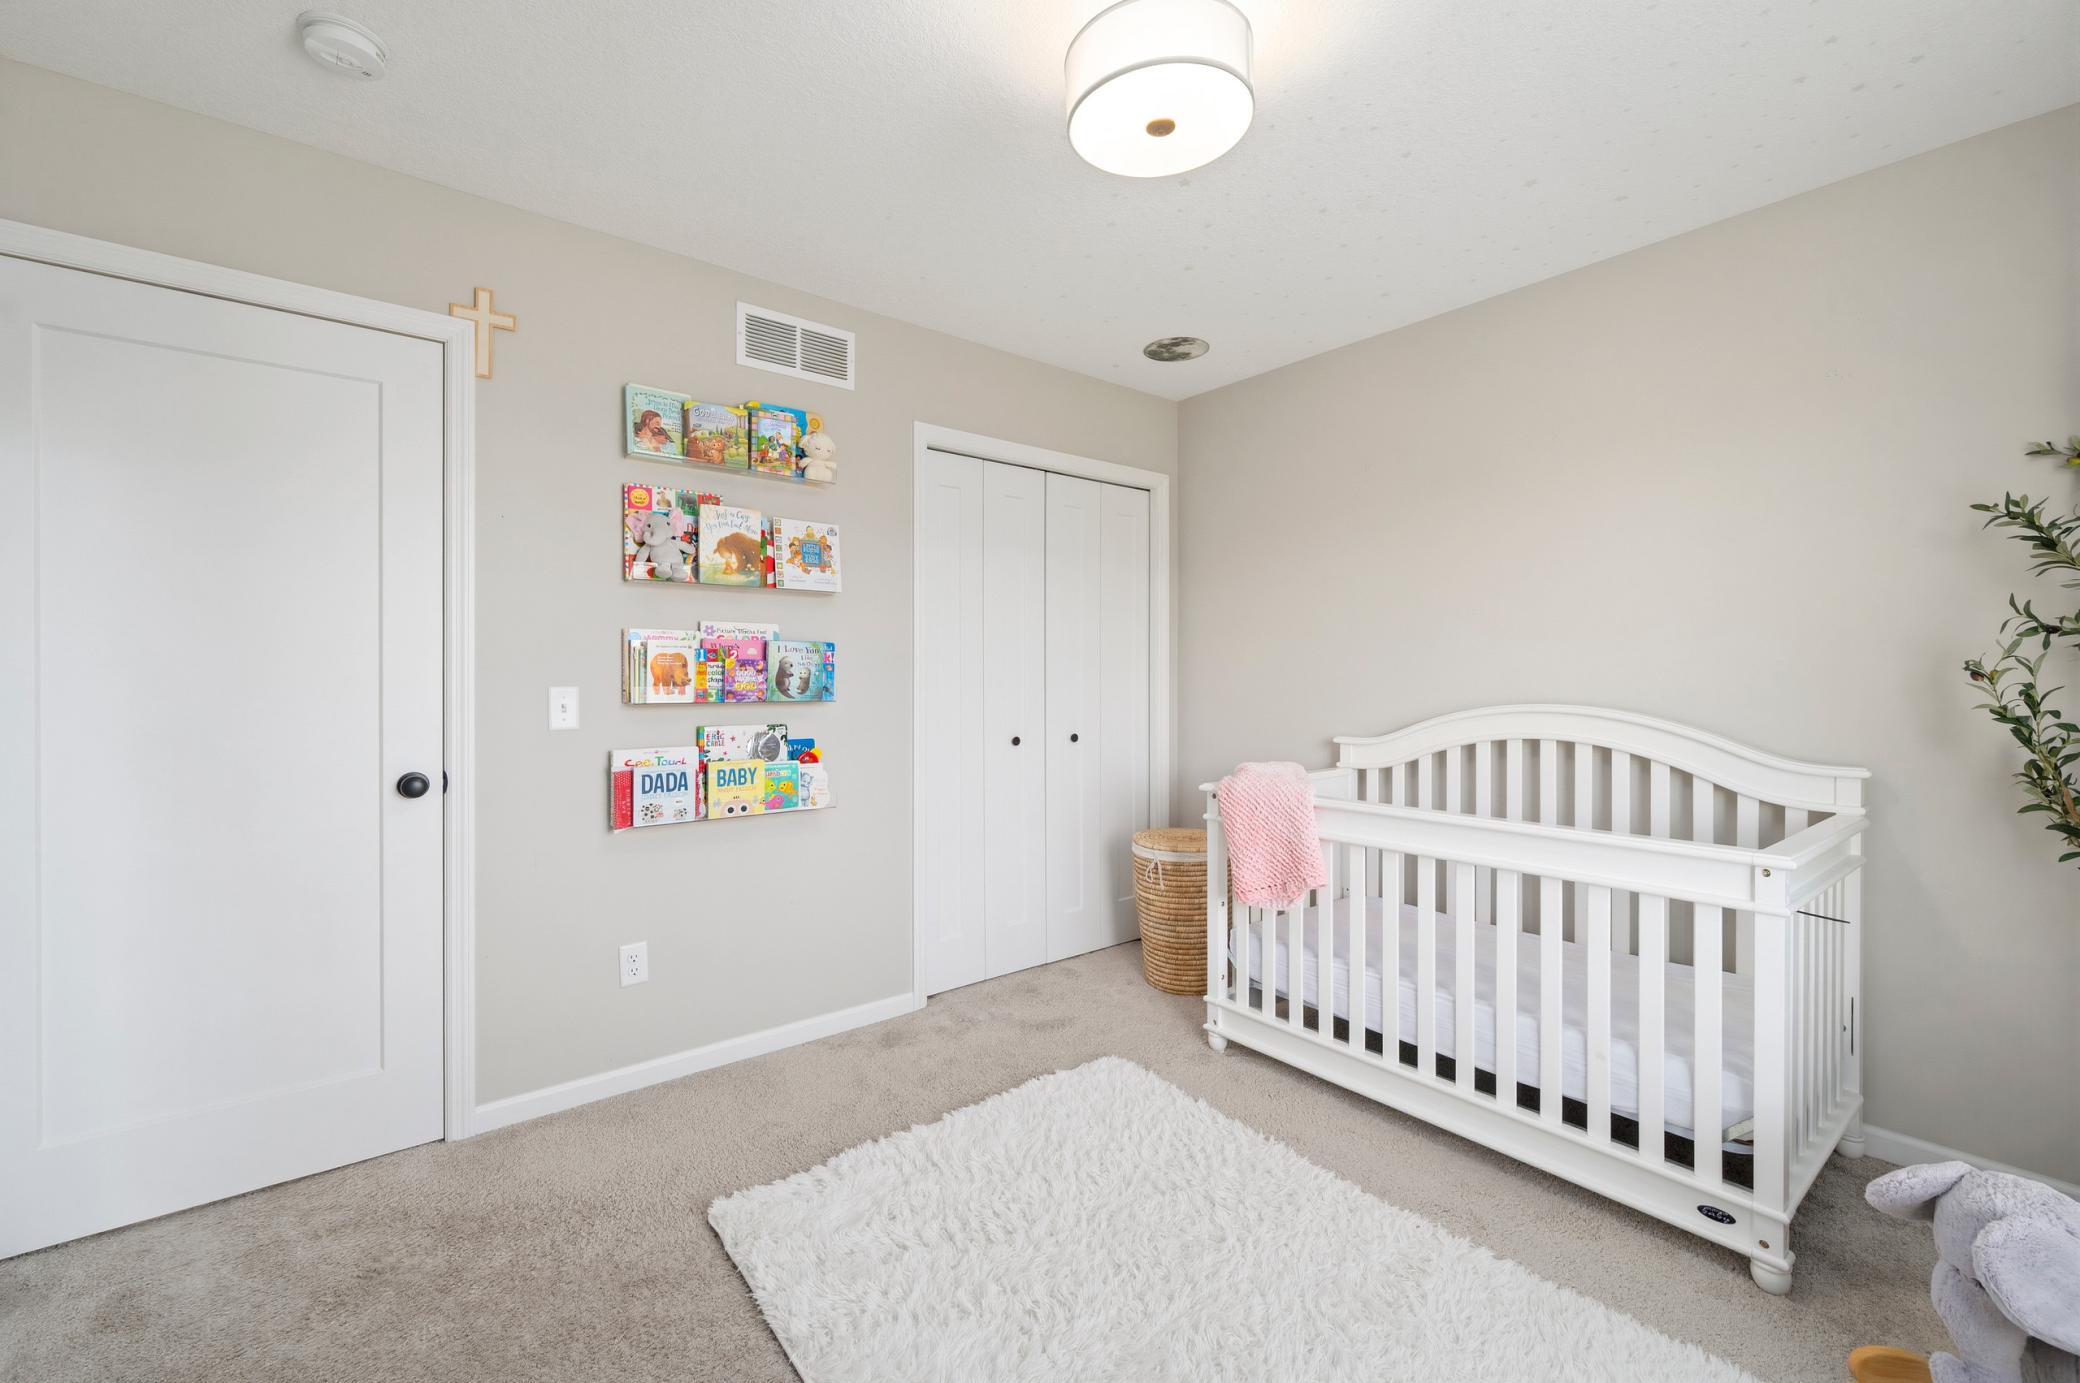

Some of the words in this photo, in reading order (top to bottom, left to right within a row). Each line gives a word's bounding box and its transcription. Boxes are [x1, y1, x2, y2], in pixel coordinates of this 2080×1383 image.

[777, 645, 780, 653] I
[784, 645, 803, 654] Love
[805, 646, 821, 655] You
[641, 771, 689, 795] DADA
[717, 767, 758, 788] BABY
